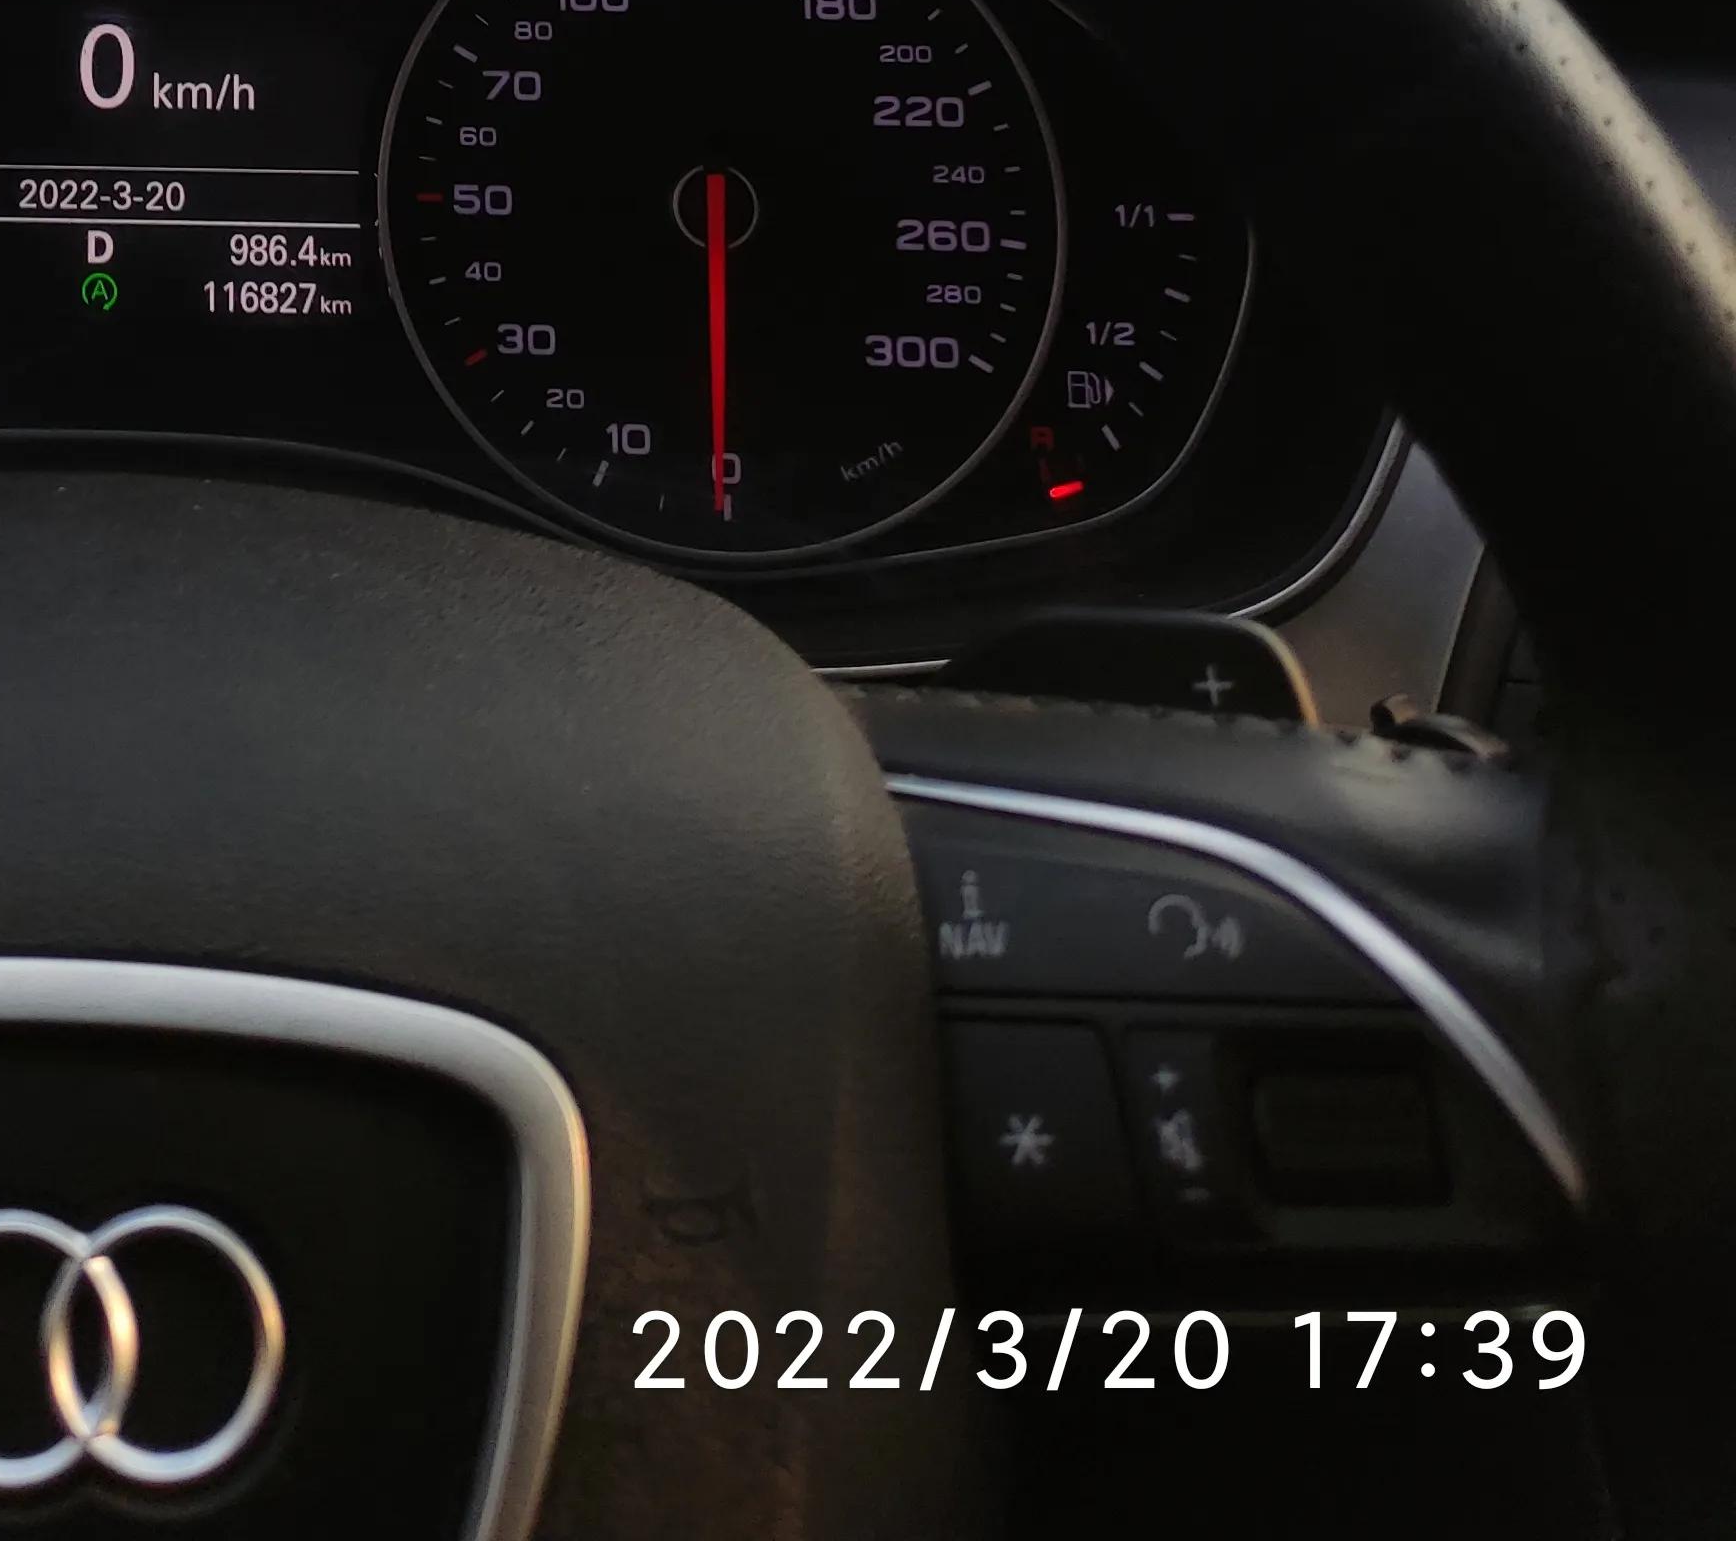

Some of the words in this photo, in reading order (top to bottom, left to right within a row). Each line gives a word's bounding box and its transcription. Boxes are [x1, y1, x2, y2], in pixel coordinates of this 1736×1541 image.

[515, 21, 552, 40] 80
[80, 24, 134, 109] 0
[154, 73, 254, 110] km/h
[880, 45, 931, 62] 200
[483, 71, 541, 100] 70
[874, 96, 964, 127] 220
[460, 127, 496, 146] 60
[933, 165, 984, 183] 240
[19, 179, 185, 211] 2022-3-20
[454, 185, 512, 215] 50
[1115, 204, 1154, 227] 1/1
[88, 230, 113, 263] D
[897, 220, 990, 251] 260
[465, 262, 501, 281] 40
[927, 285, 981, 303] 280
[498, 324, 555, 355] 30
[1086, 322, 1134, 345] 1/2
[866, 335, 958, 368] 300
[547, 389, 584, 408] 20
[606, 424, 650, 454] 10
[841, 442, 902, 481] km/h
